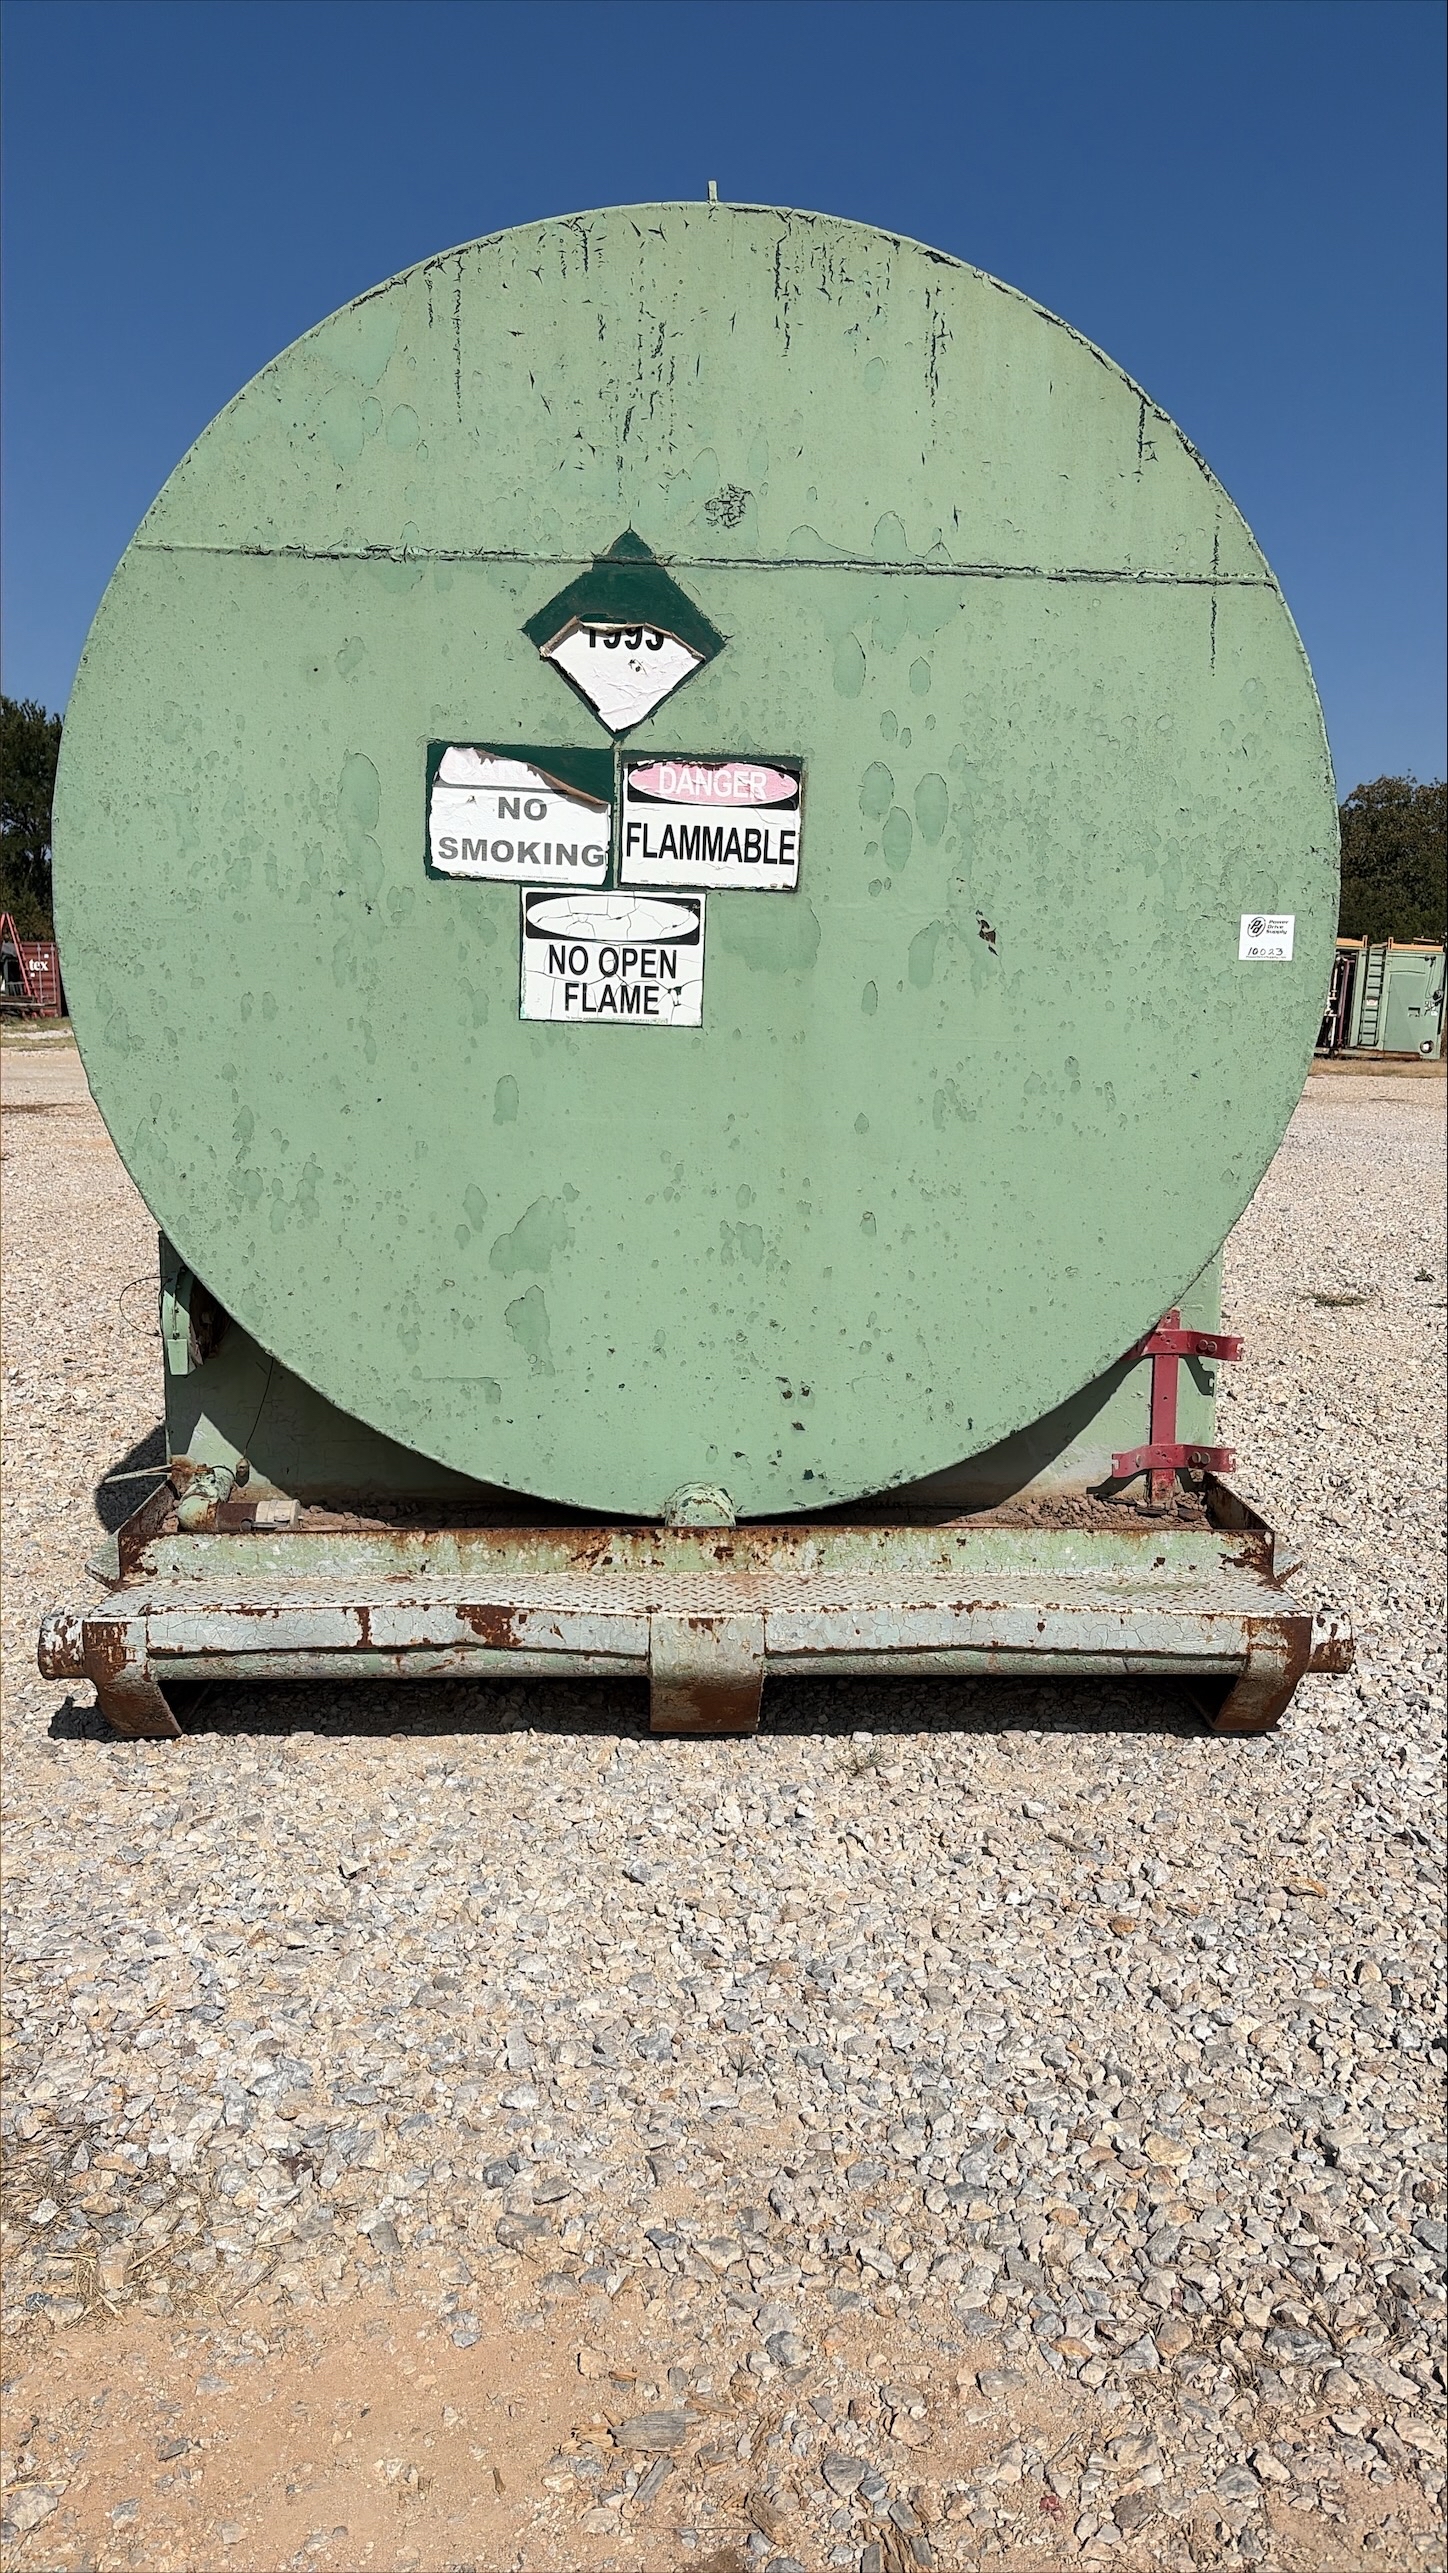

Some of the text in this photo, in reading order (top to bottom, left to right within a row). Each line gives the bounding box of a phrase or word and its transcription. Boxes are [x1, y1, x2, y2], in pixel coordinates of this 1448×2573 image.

[659, 766, 767, 800] DANGER
[498, 796, 547, 821] NO
[438, 837, 604, 867] SMOKING
[626, 822, 796, 866] FLAMMABLE
[29, 959, 49, 971] tex
[549, 944, 677, 979] NO OPEN
[1248, 947, 1283, 956] 10023
[564, 982, 660, 1015] FLAME
